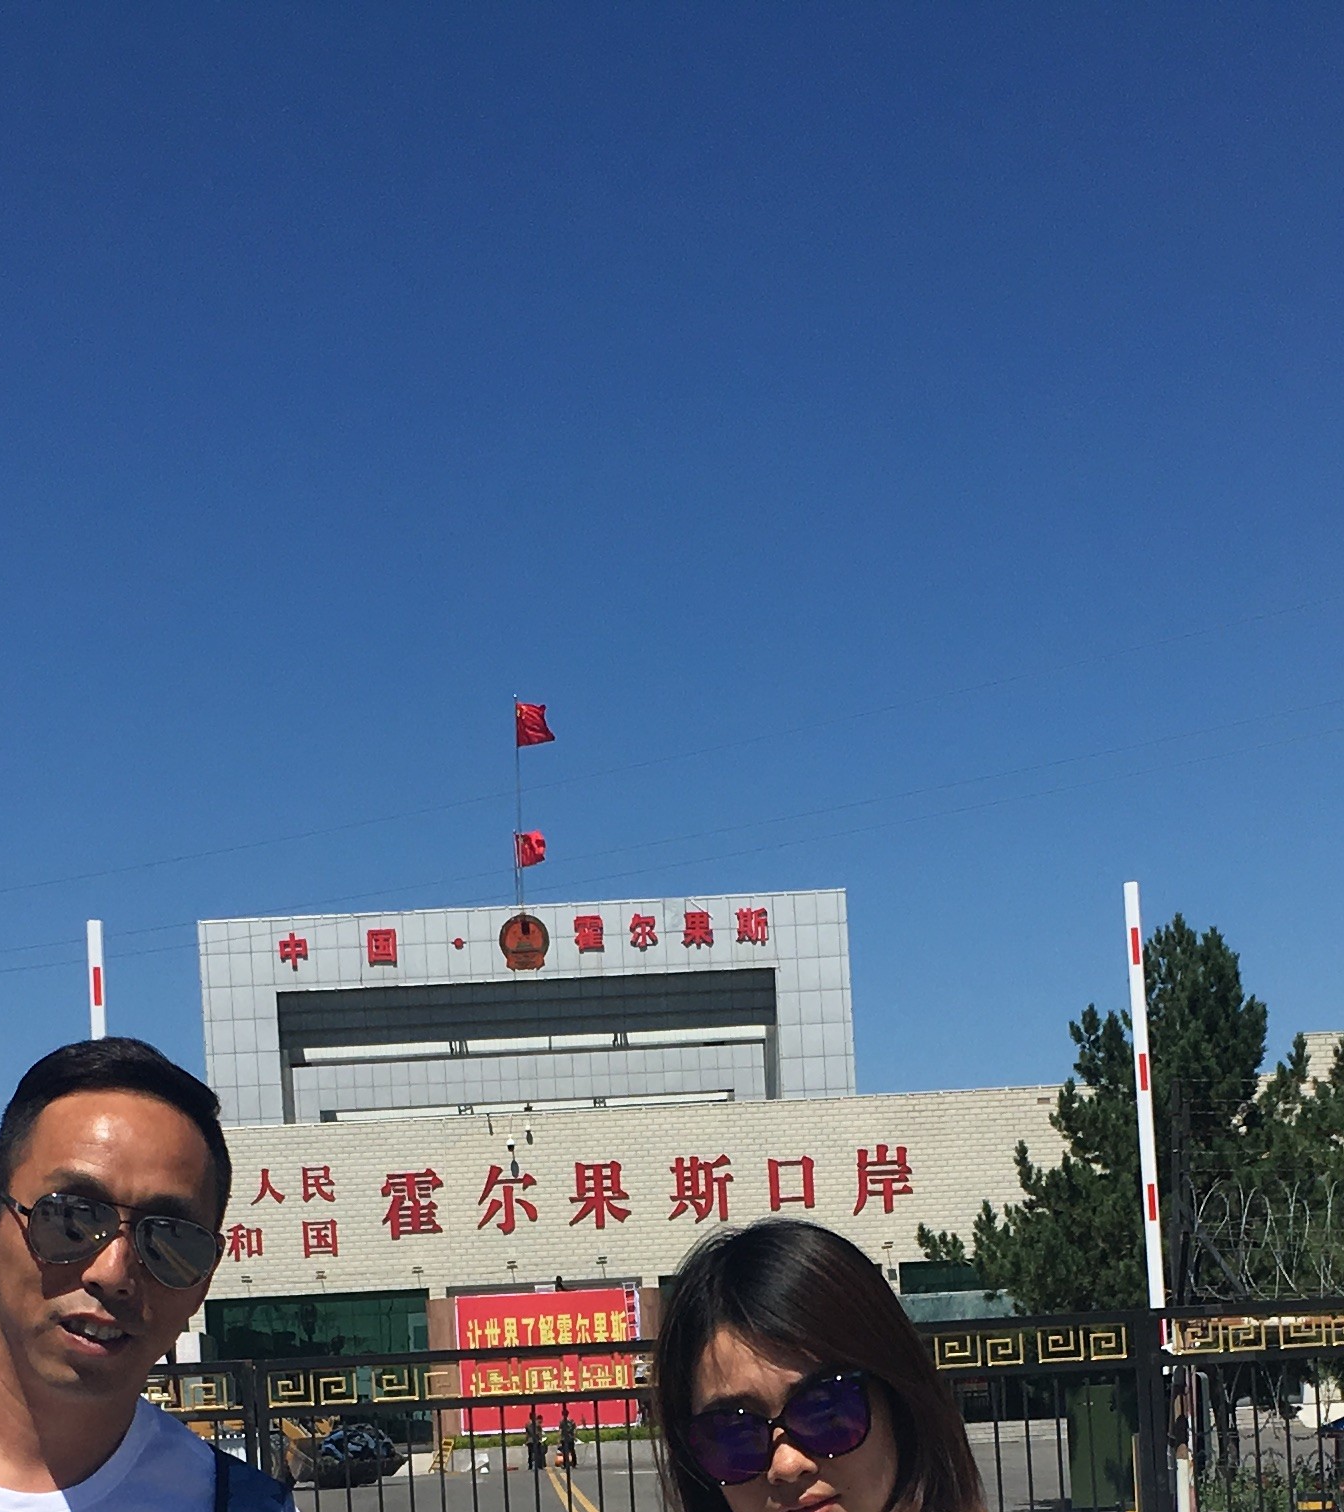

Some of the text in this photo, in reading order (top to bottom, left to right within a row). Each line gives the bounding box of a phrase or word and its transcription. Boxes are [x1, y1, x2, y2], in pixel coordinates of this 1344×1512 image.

[380, 1143, 914, 1241] 霍尔果斯口岸
[466, 1310, 627, 1349] 让世界了解霍尔果斯
